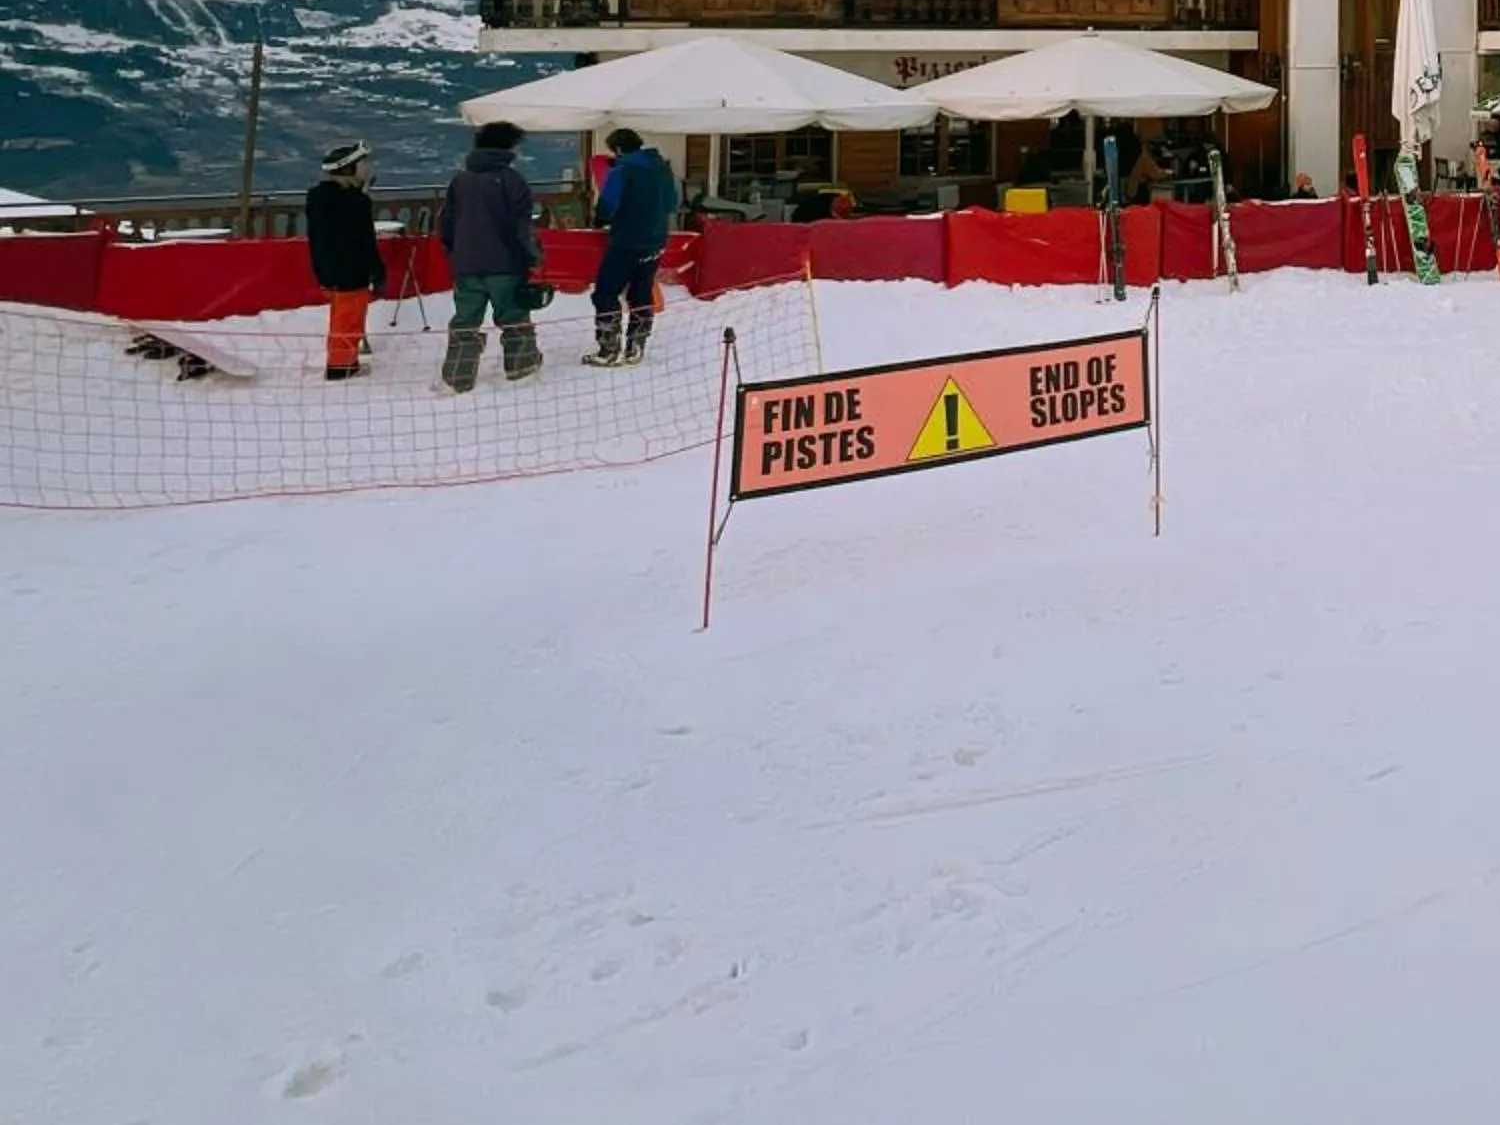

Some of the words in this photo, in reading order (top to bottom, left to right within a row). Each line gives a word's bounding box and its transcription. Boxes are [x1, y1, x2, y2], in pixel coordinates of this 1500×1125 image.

[1029, 361, 1083, 397] END
[1086, 354, 1117, 386] OF
[762, 394, 816, 435] FIN
[823, 388, 862, 426] DE
[1029, 384, 1127, 428] SLOPES
[760, 426, 876, 476] PISTES
